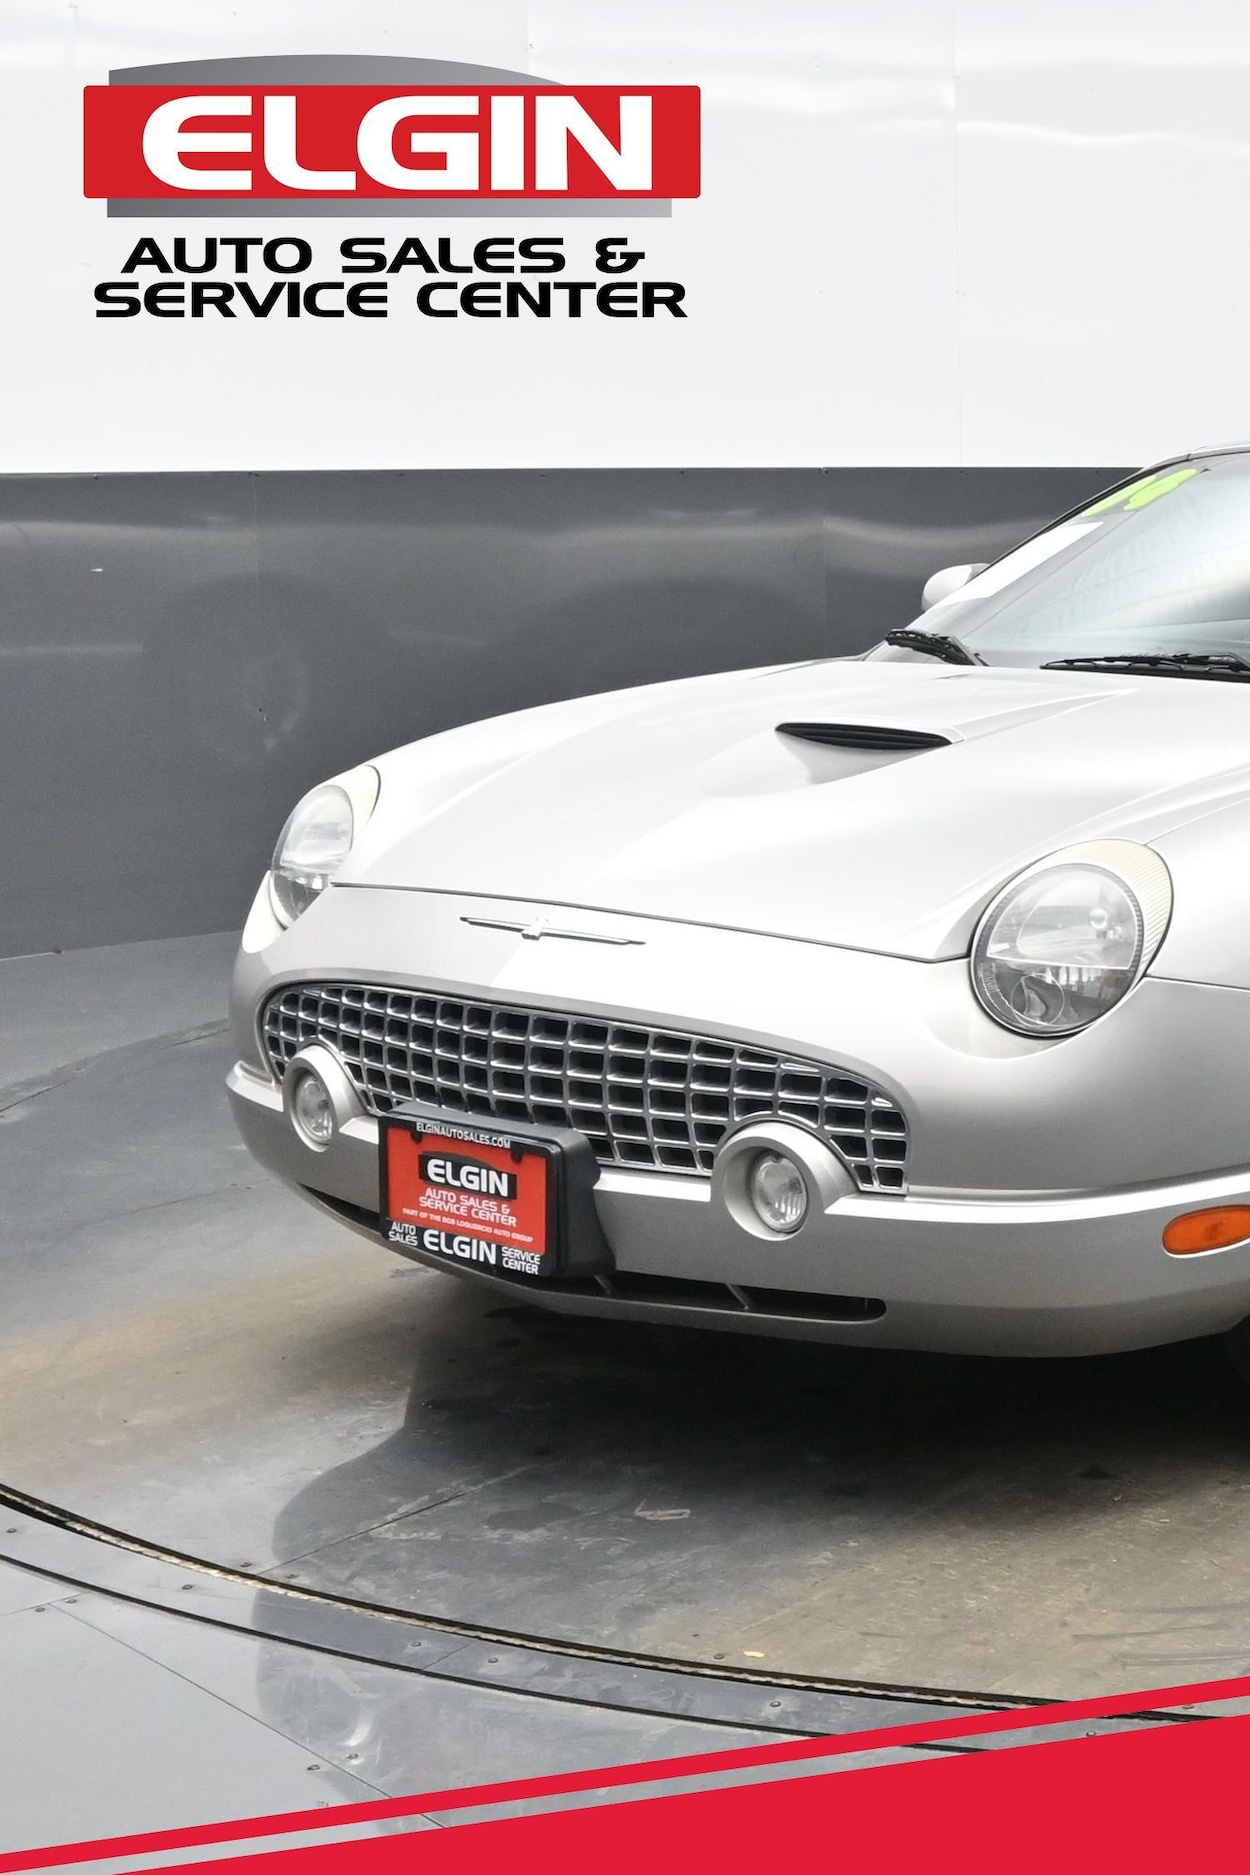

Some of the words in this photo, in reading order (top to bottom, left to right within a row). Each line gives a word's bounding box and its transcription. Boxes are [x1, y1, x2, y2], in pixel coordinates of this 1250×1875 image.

[416, 1122, 511, 1149] ELGINAUTOSALES.COM
[427, 1158, 508, 1197] ELGIN
[419, 1196, 468, 1217] SERVICE
[471, 1208, 517, 1228] CENTER
[425, 1187, 456, 1203] AUTO
[459, 1195, 497, 1213] SALES
[501, 1203, 511, 1215] &
[388, 1231, 418, 1247] SALES
[391, 1221, 416, 1236] AUTO
[423, 1229, 497, 1265] ELGIN
[501, 1246, 541, 1265] SERVICE
[502, 1258, 539, 1276] CENTER
